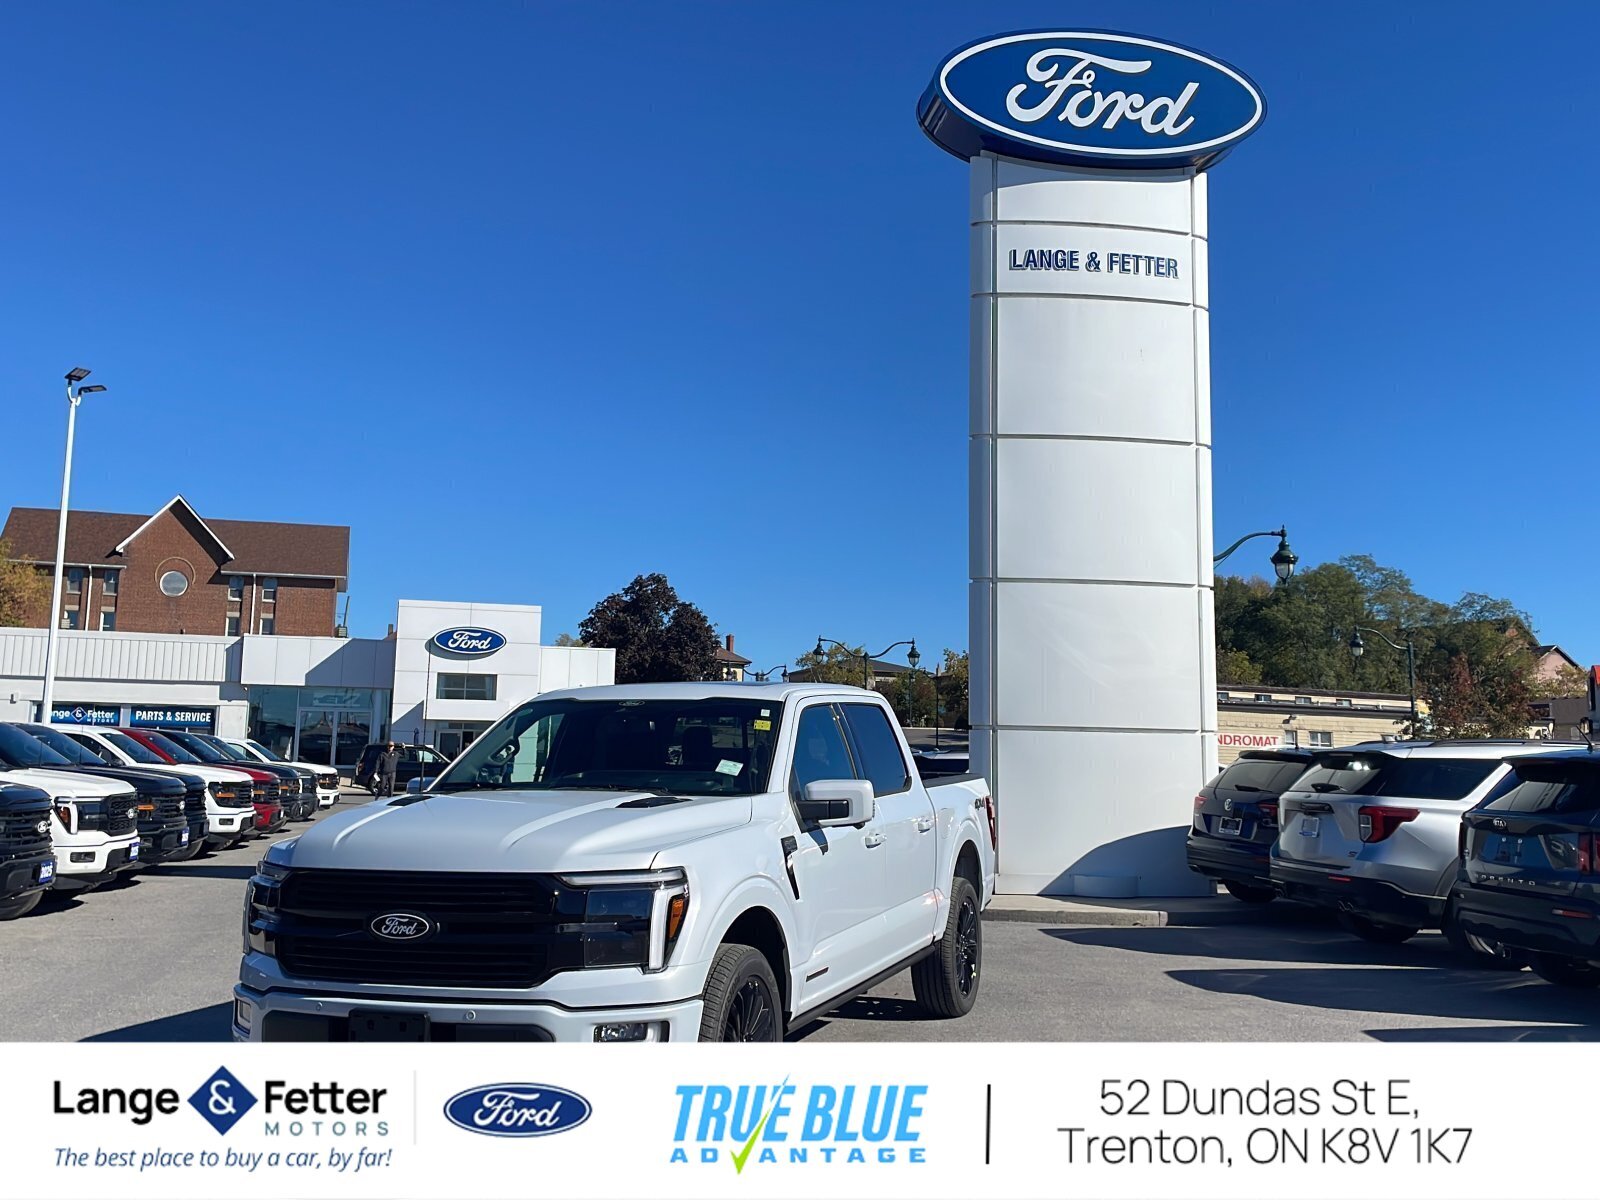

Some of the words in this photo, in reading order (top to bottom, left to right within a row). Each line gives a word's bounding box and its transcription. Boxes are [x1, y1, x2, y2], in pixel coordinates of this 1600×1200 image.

[1005, 48, 1200, 136] Ford
[1009, 249, 1080, 271] LANGE
[1085, 251, 1101, 272] &
[1107, 252, 1179, 279] FETTER
[448, 631, 492, 649] Ford
[51, 710, 70, 719] nge
[87, 710, 115, 719] Fetter
[135, 711, 164, 721] PARTS
[166, 711, 173, 721] &
[174, 712, 212, 723] SERVICE
[381, 916, 418, 935] Ford
